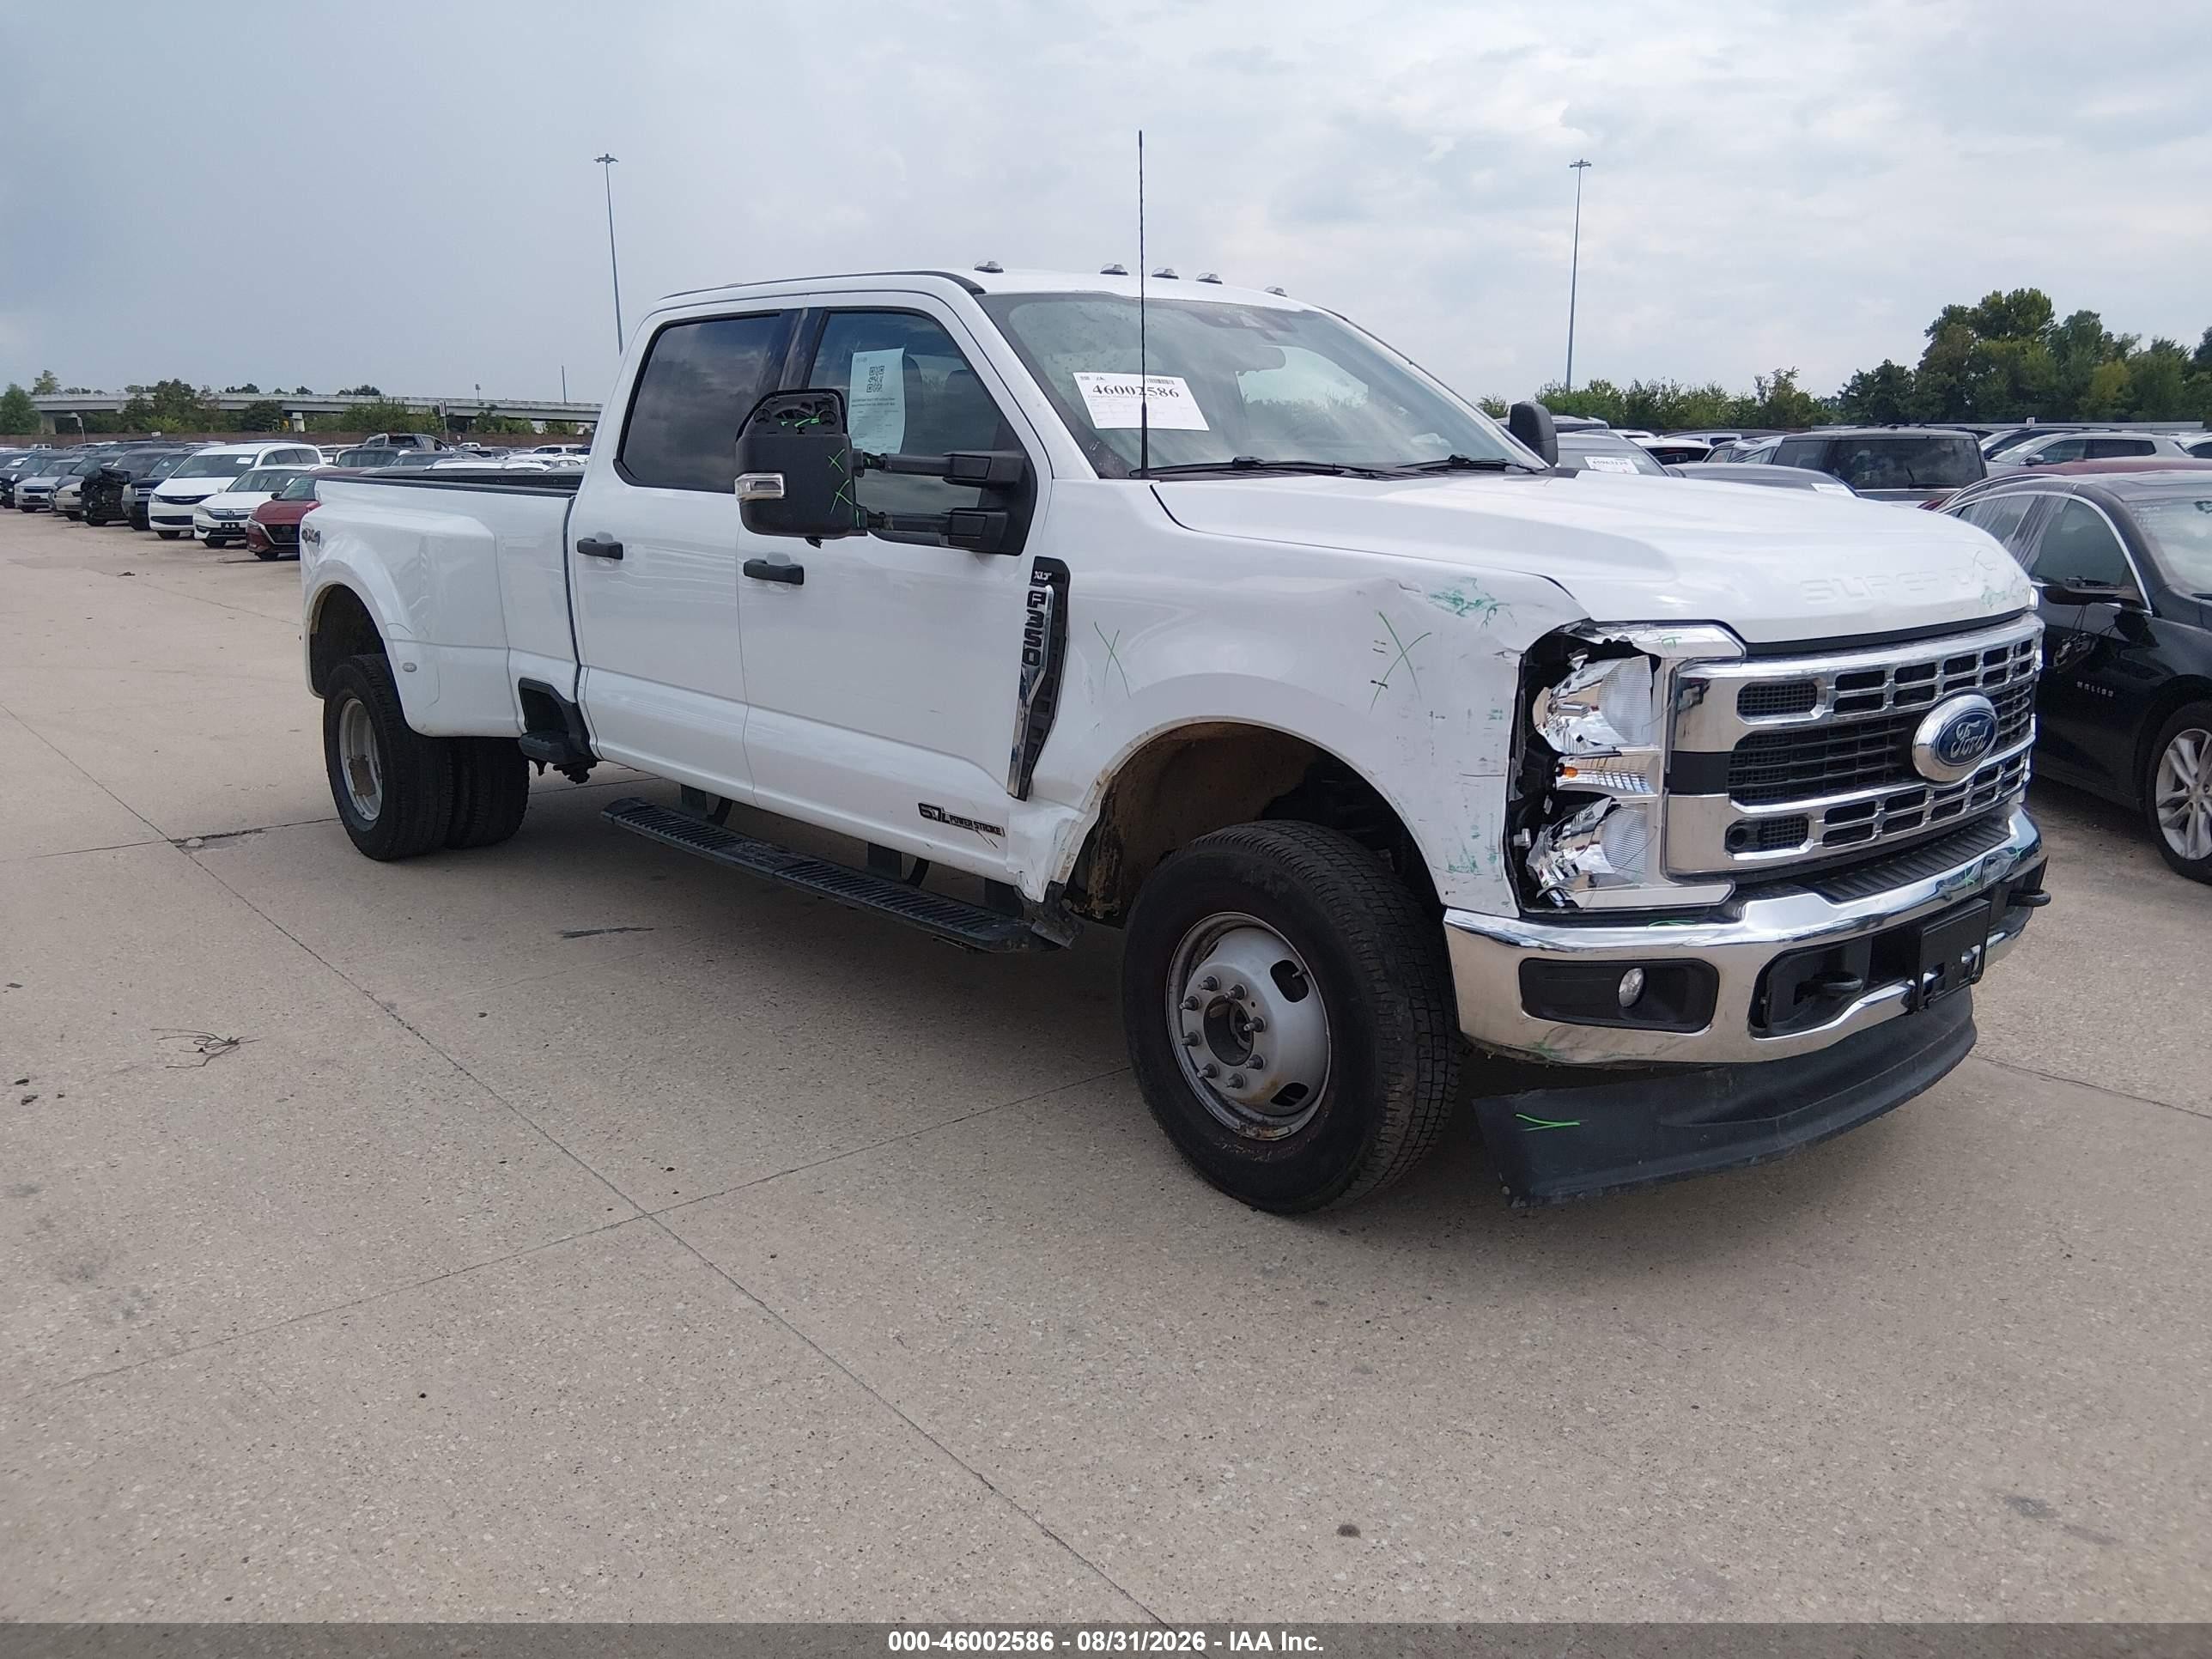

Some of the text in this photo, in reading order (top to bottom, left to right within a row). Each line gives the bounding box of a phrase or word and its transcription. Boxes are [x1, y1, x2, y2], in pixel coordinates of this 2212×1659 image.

[1092, 385, 1179, 398] 46002586
[1033, 570, 1053, 580] XLT
[1950, 720, 1989, 759] Ford
[950, 814, 973, 829] POWER
[973, 821, 1002, 836] STROKE
